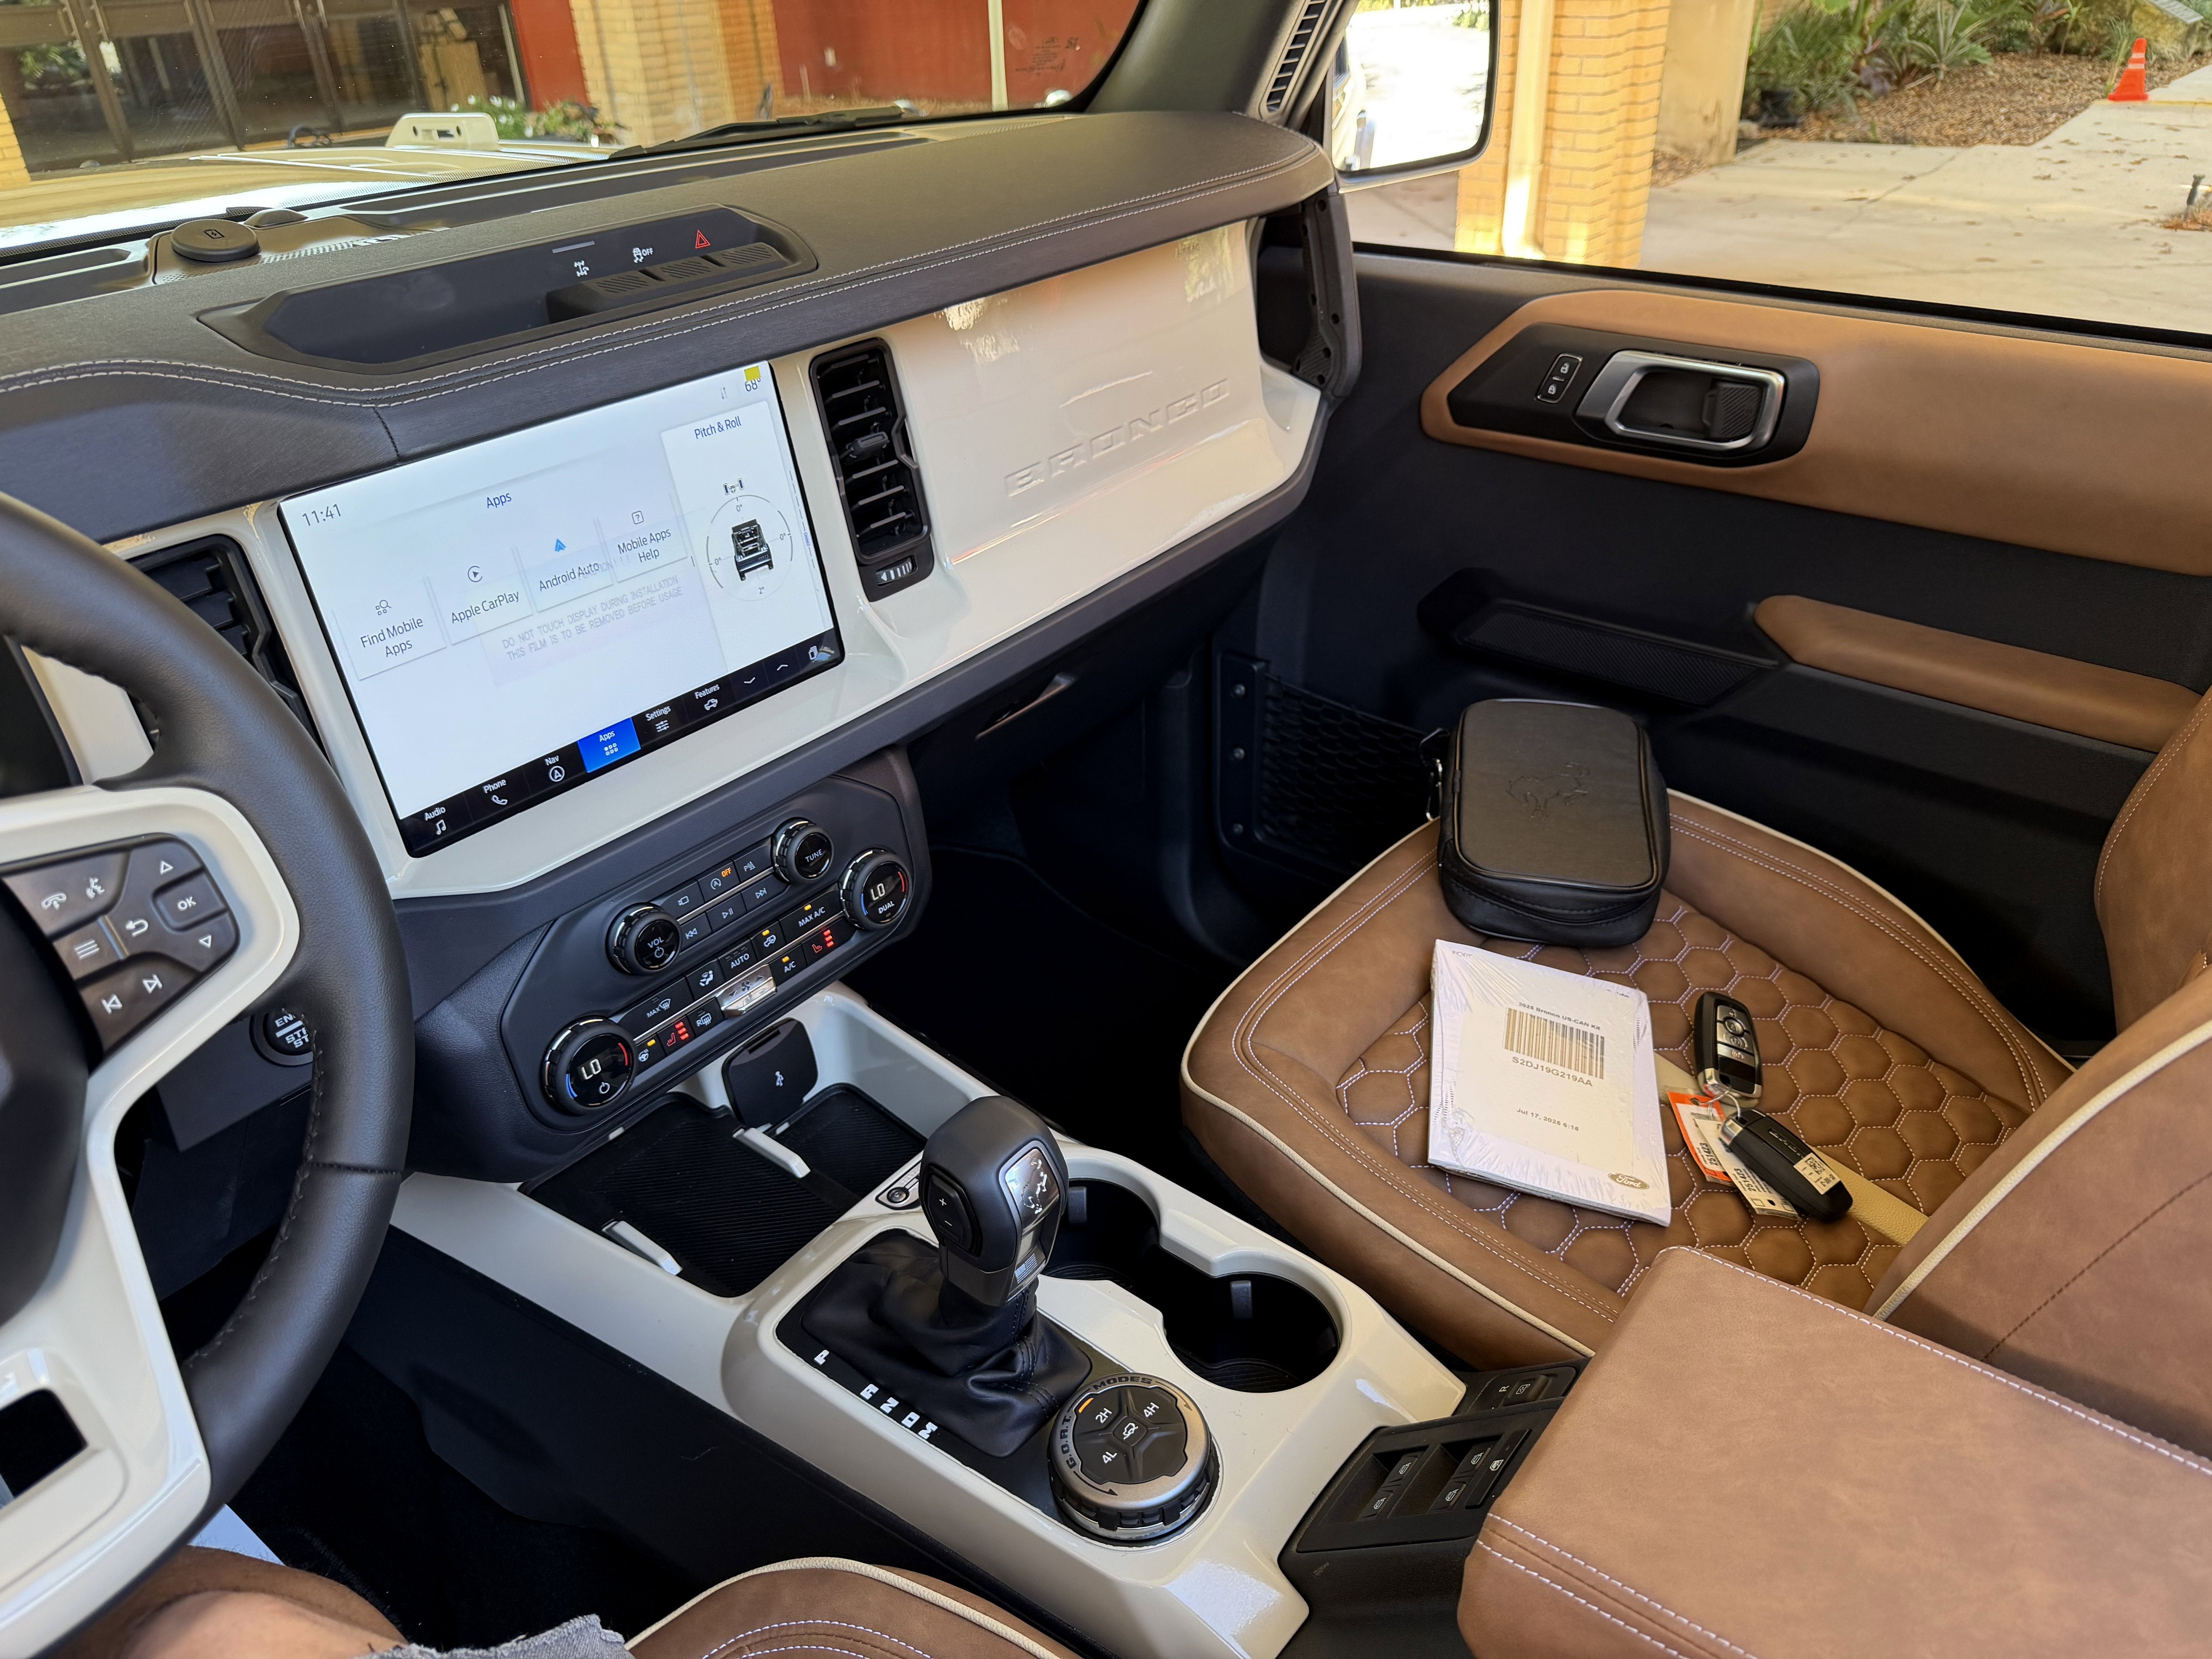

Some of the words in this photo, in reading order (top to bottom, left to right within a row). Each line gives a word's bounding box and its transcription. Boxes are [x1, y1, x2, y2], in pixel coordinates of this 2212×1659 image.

[642, 248, 653, 256] OFF
[695, 424, 716, 439] Pitch
[718, 422, 725, 431] &
[725, 416, 741, 429] Roll
[1005, 378, 1230, 497] BRONCO
[486, 492, 512, 508] Apps
[302, 503, 341, 526] 11:41
[618, 536, 648, 554] Mobile
[650, 529, 671, 543] Apps
[639, 548, 660, 563] Help
[539, 568, 576, 591] Android
[578, 563, 600, 577] Auto
[452, 605, 481, 623] Apple
[481, 591, 519, 612] CarPlay
[502, 637, 515, 649] DO
[518, 629, 534, 643] NOT
[537, 619, 565, 635] TOUCH
[567, 605, 597, 625] DISPLAY
[601, 594, 629, 611] DURING
[631, 575, 678, 599] INSTALLATION
[507, 647, 525, 661] THIS
[529, 640, 548, 653] FILM
[550, 635, 558, 645] IS
[561, 630, 572, 641] TO
[575, 624, 587, 635] BE
[589, 609, 625, 629] REMOVED
[627, 597, 657, 615] BEFORE
[660, 586, 684, 603] USAGE
[361, 630, 386, 648] Find
[386, 618, 424, 639] Mobile
[385, 640, 412, 657] Apps
[695, 684, 720, 699] Features
[646, 705, 671, 721] Settings
[599, 731, 615, 742] Apps
[545, 755, 559, 766] Nav
[483, 779, 507, 793] Phone
[424, 807, 446, 821] Audio
[805, 849, 823, 862] TUNE
[721, 867, 732, 878] OFF
[871, 883, 885, 901] LO
[177, 896, 196, 910] OK
[878, 901, 895, 914] DUAL
[798, 914, 813, 927] MAX
[814, 907, 825, 918] A/C
[647, 937, 664, 948] VOL
[731, 953, 750, 969] AUTO
[784, 961, 796, 973] A/C
[646, 1007, 661, 1018] MAX
[1536, 1007, 1560, 1018] Bronco
[1562, 1015, 1589, 1027] US-CAN
[581, 1058, 601, 1080] LO
[1512, 1056, 1593, 1087] S2DJ19G219AA
[1700, 1143, 1718, 1166] 251423
[1615, 1175, 1642, 1188] Ford
[1734, 1168, 1756, 1192] 251423
[814, 1350, 830, 1365] P
[1093, 1376, 1152, 1390] MODES
[880, 1397, 899, 1413] N
[1143, 1402, 1159, 1418] 4H
[1096, 1408, 1112, 1423] 2H
[918, 1422, 938, 1439] M
[1102, 1451, 1117, 1464] 4L
